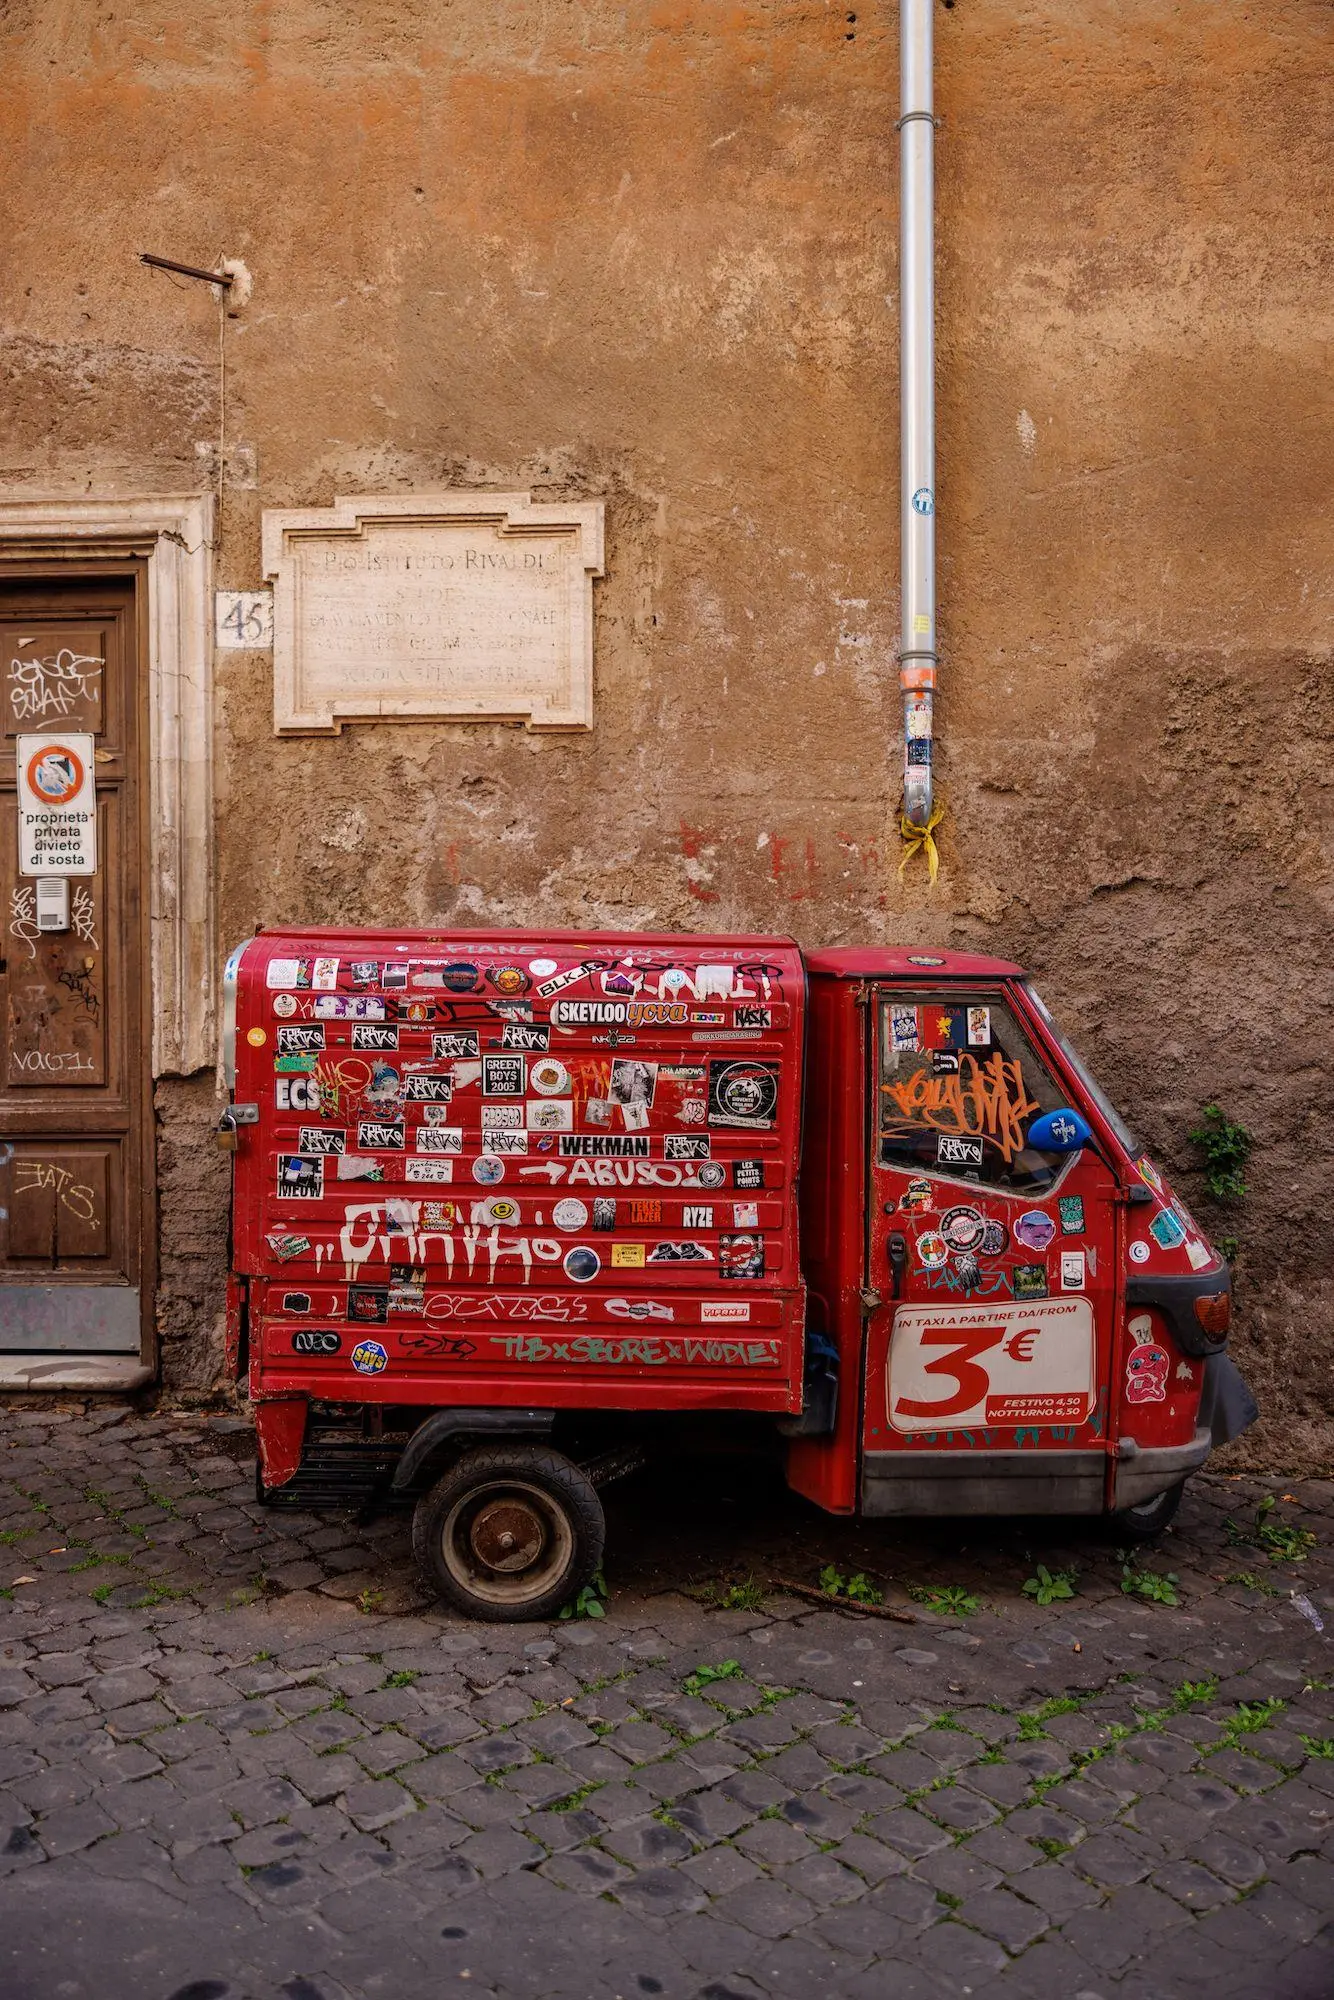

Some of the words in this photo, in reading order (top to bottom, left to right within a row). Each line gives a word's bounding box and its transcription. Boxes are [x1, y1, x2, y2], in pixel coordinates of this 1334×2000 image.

[220, 599, 265, 641] 45
[26, 811, 89, 825] proprietà
[34, 826, 81, 839] privata
[34, 840, 81, 851] divieto
[30, 853, 43, 865] di
[48, 854, 85, 865] sosta
[559, 1002, 625, 1022] SKEYLOO
[486, 1059, 521, 1070] GREEN
[489, 1070, 518, 1081] BOYS
[660, 1067, 674, 1075] THA
[674, 1067, 704, 1076] ARROWS
[490, 1081, 516, 1092] 2005
[561, 1136, 649, 1156] WEKMAN
[741, 1161, 754, 1169] LES
[736, 1169, 759, 1177] PETITS
[737, 1176, 761, 1184] POINTS
[630, 1211, 662, 1223] LAZER
[682, 1206, 714, 1228] RYZE
[898, 1319, 912, 1329] IN
[916, 1317, 945, 1327] TAXI
[946, 1316, 956, 1325] A
[959, 1311, 1014, 1324] PARTIRE
[1017, 1305, 1078, 1318] DA/FROM
[1004, 1397, 1055, 1408] FESTIVO
[1055, 1397, 1081, 1406] 4,50
[988, 1408, 1054, 1418] NOTTURNO
[1055, 1407, 1081, 1416] 6,50
